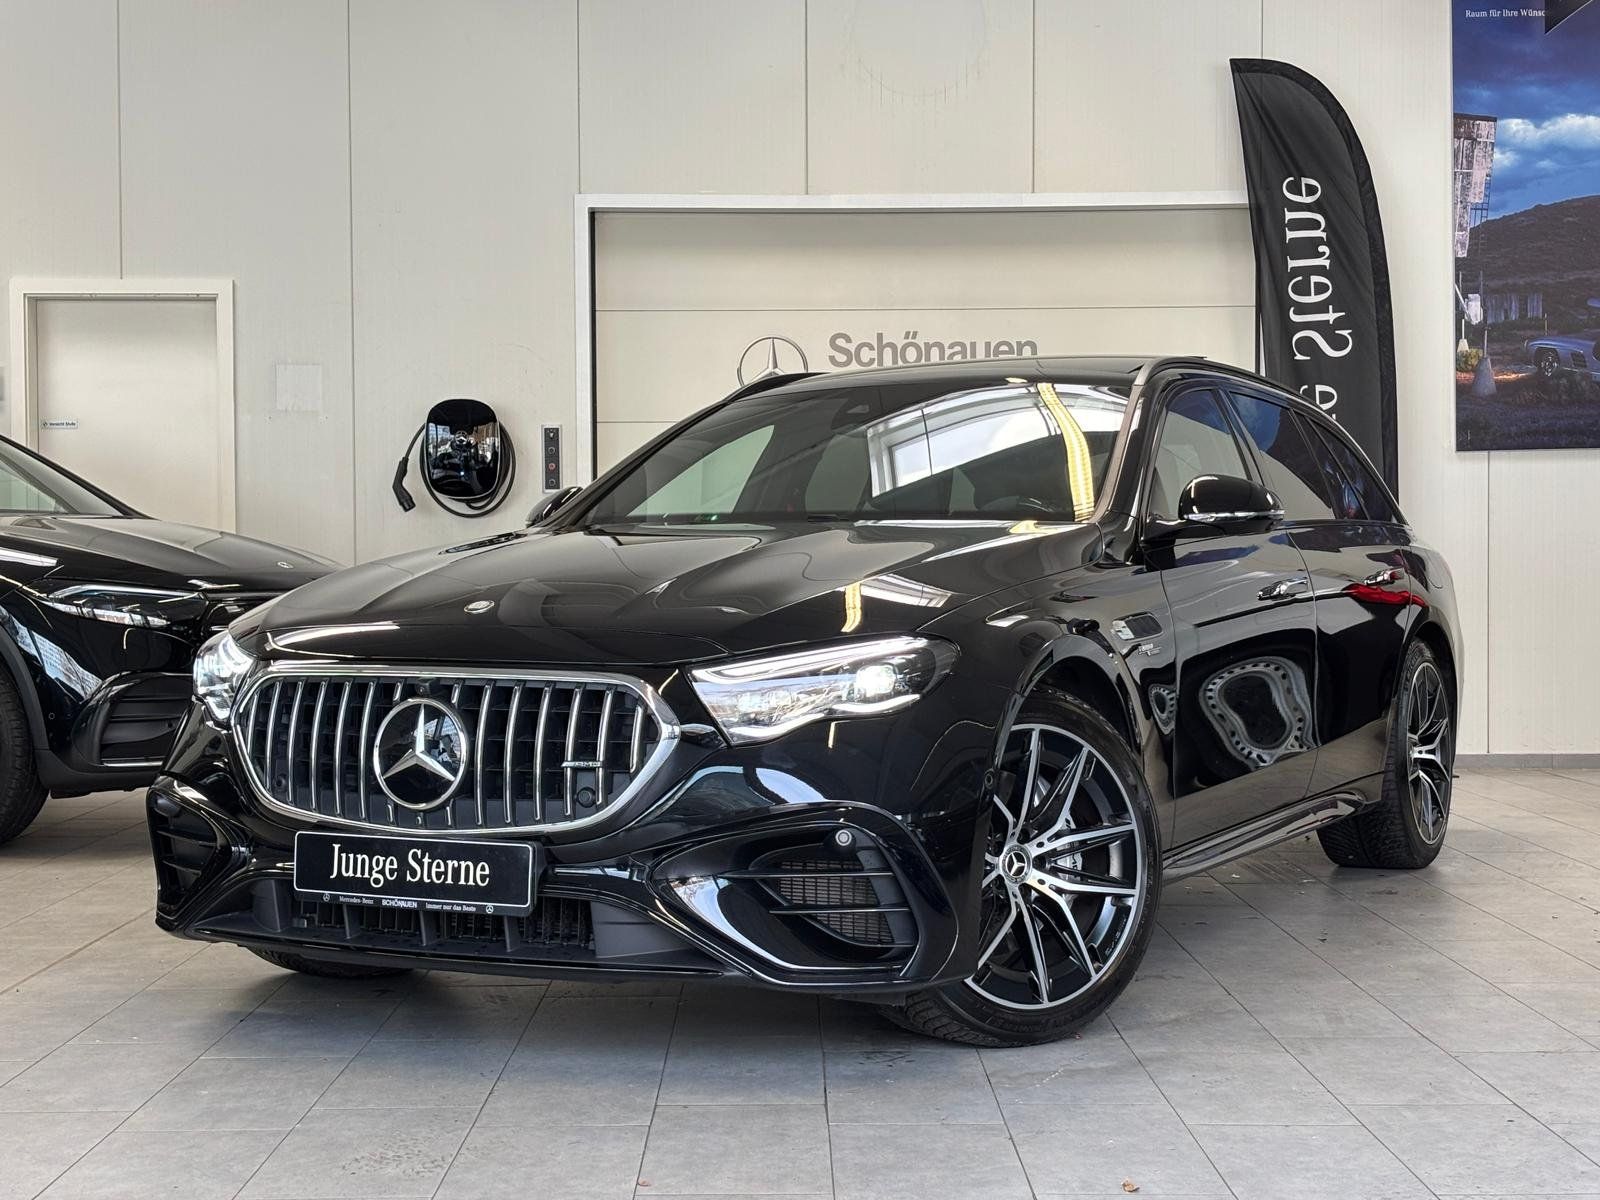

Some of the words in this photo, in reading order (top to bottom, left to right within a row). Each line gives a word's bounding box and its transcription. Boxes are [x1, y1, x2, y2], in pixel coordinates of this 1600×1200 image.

[1465, 10, 1488, 18] Raum
[1489, 9, 1501, 17] für
[1502, 9, 1518, 17] Ihre
[828, 331, 1038, 368] Schönauen
[330, 843, 398, 888] Junge
[406, 848, 490, 887] Sterne
[381, 898, 418, 909] SCHÖNAUEN
